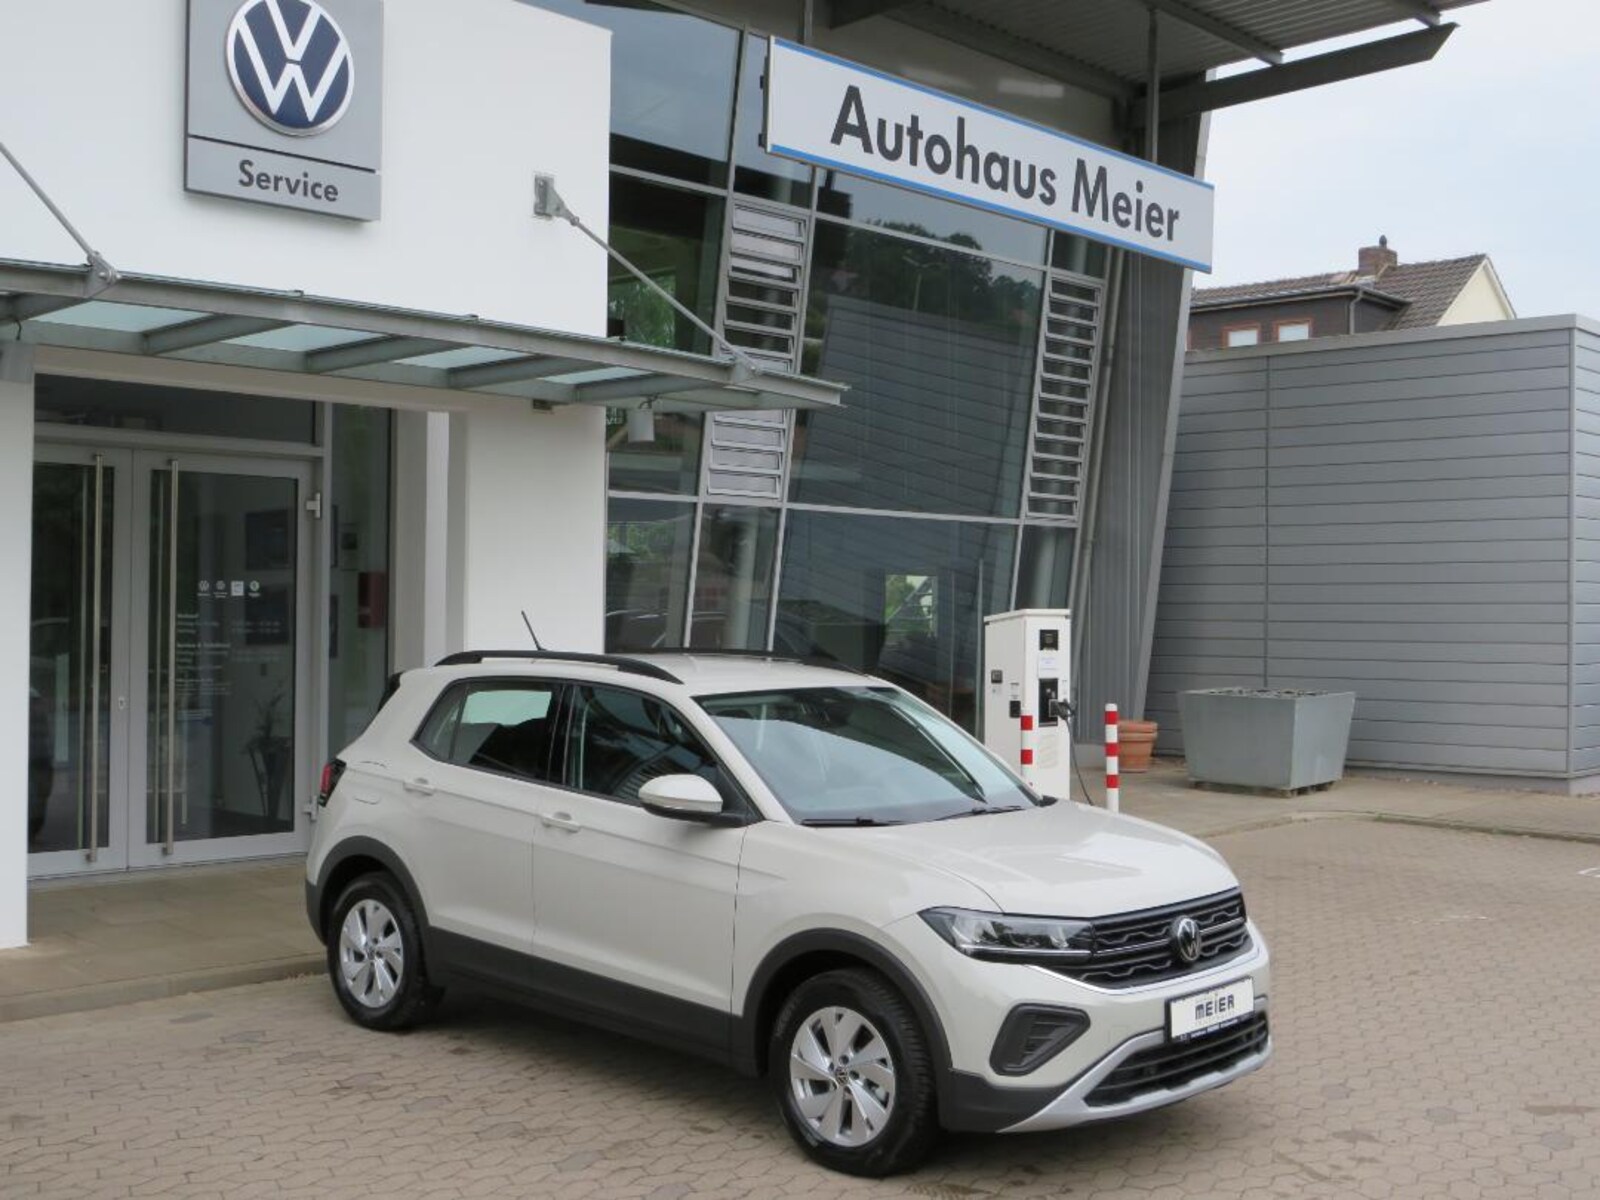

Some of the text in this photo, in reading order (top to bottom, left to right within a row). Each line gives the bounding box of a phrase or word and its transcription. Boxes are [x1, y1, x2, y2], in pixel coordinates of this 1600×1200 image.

[238, 159, 339, 202] Service
[830, 85, 1180, 242] Autohaus Meier
